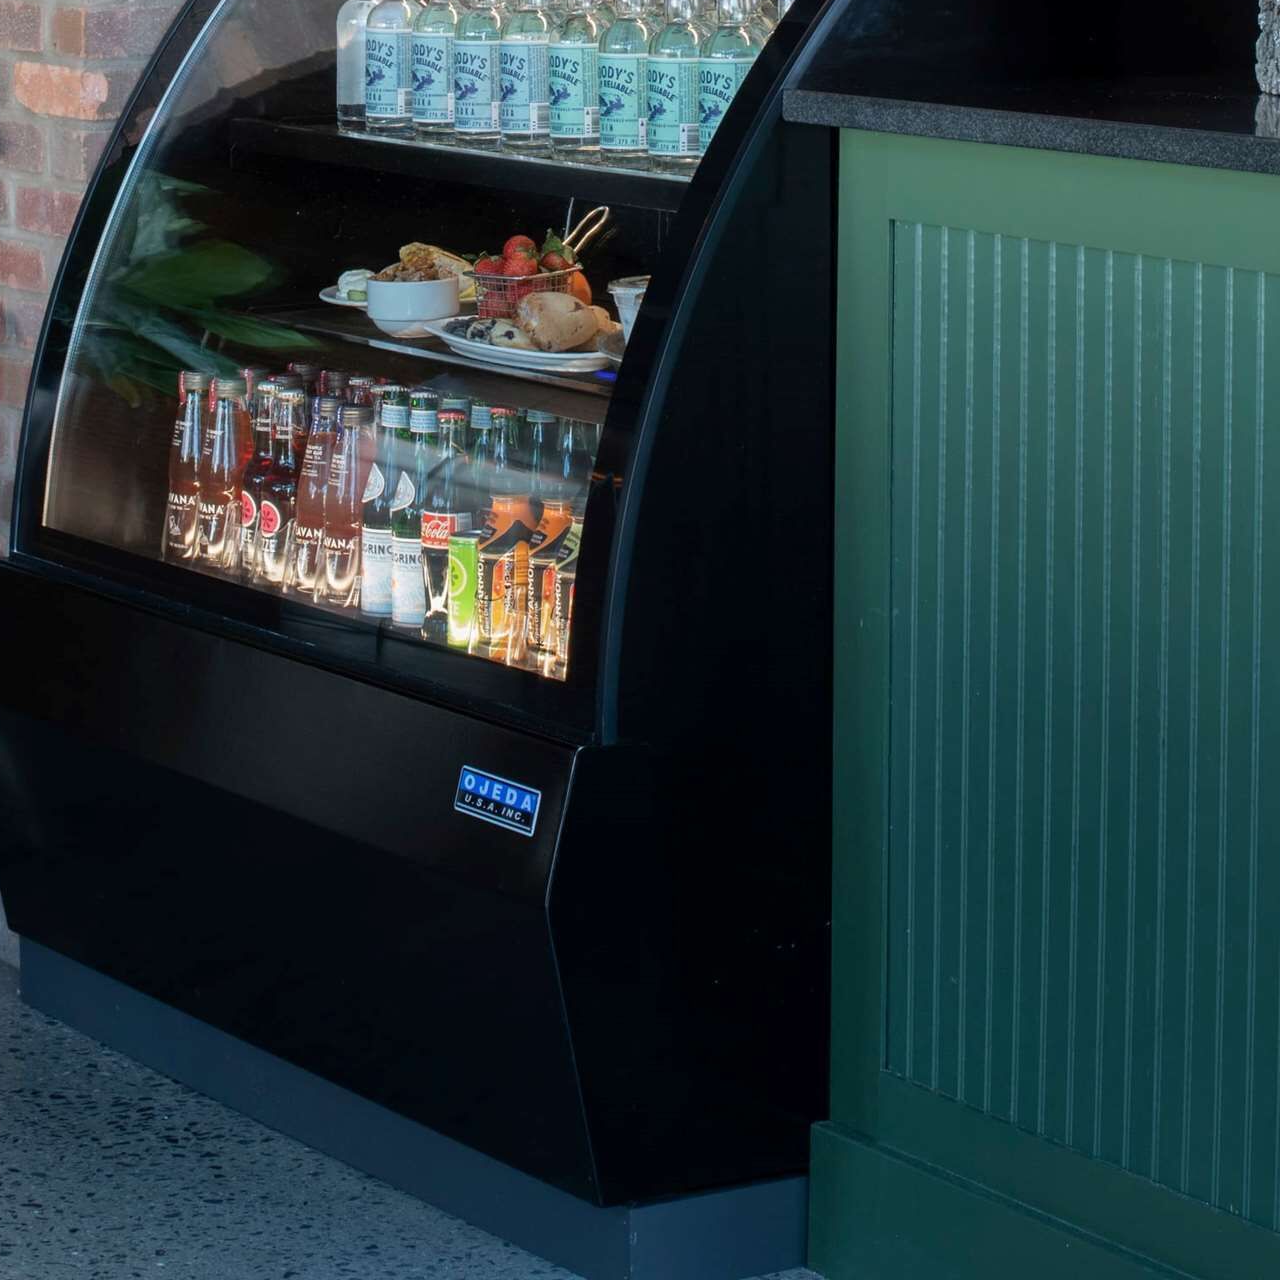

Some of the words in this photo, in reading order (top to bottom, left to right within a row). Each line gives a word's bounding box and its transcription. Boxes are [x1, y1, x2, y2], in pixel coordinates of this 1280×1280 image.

[454, 52, 488, 69] ODY'S
[599, 65, 635, 84] ODY'S
[464, 774, 532, 813] OJEDA
[501, 807, 526, 823] INC.
